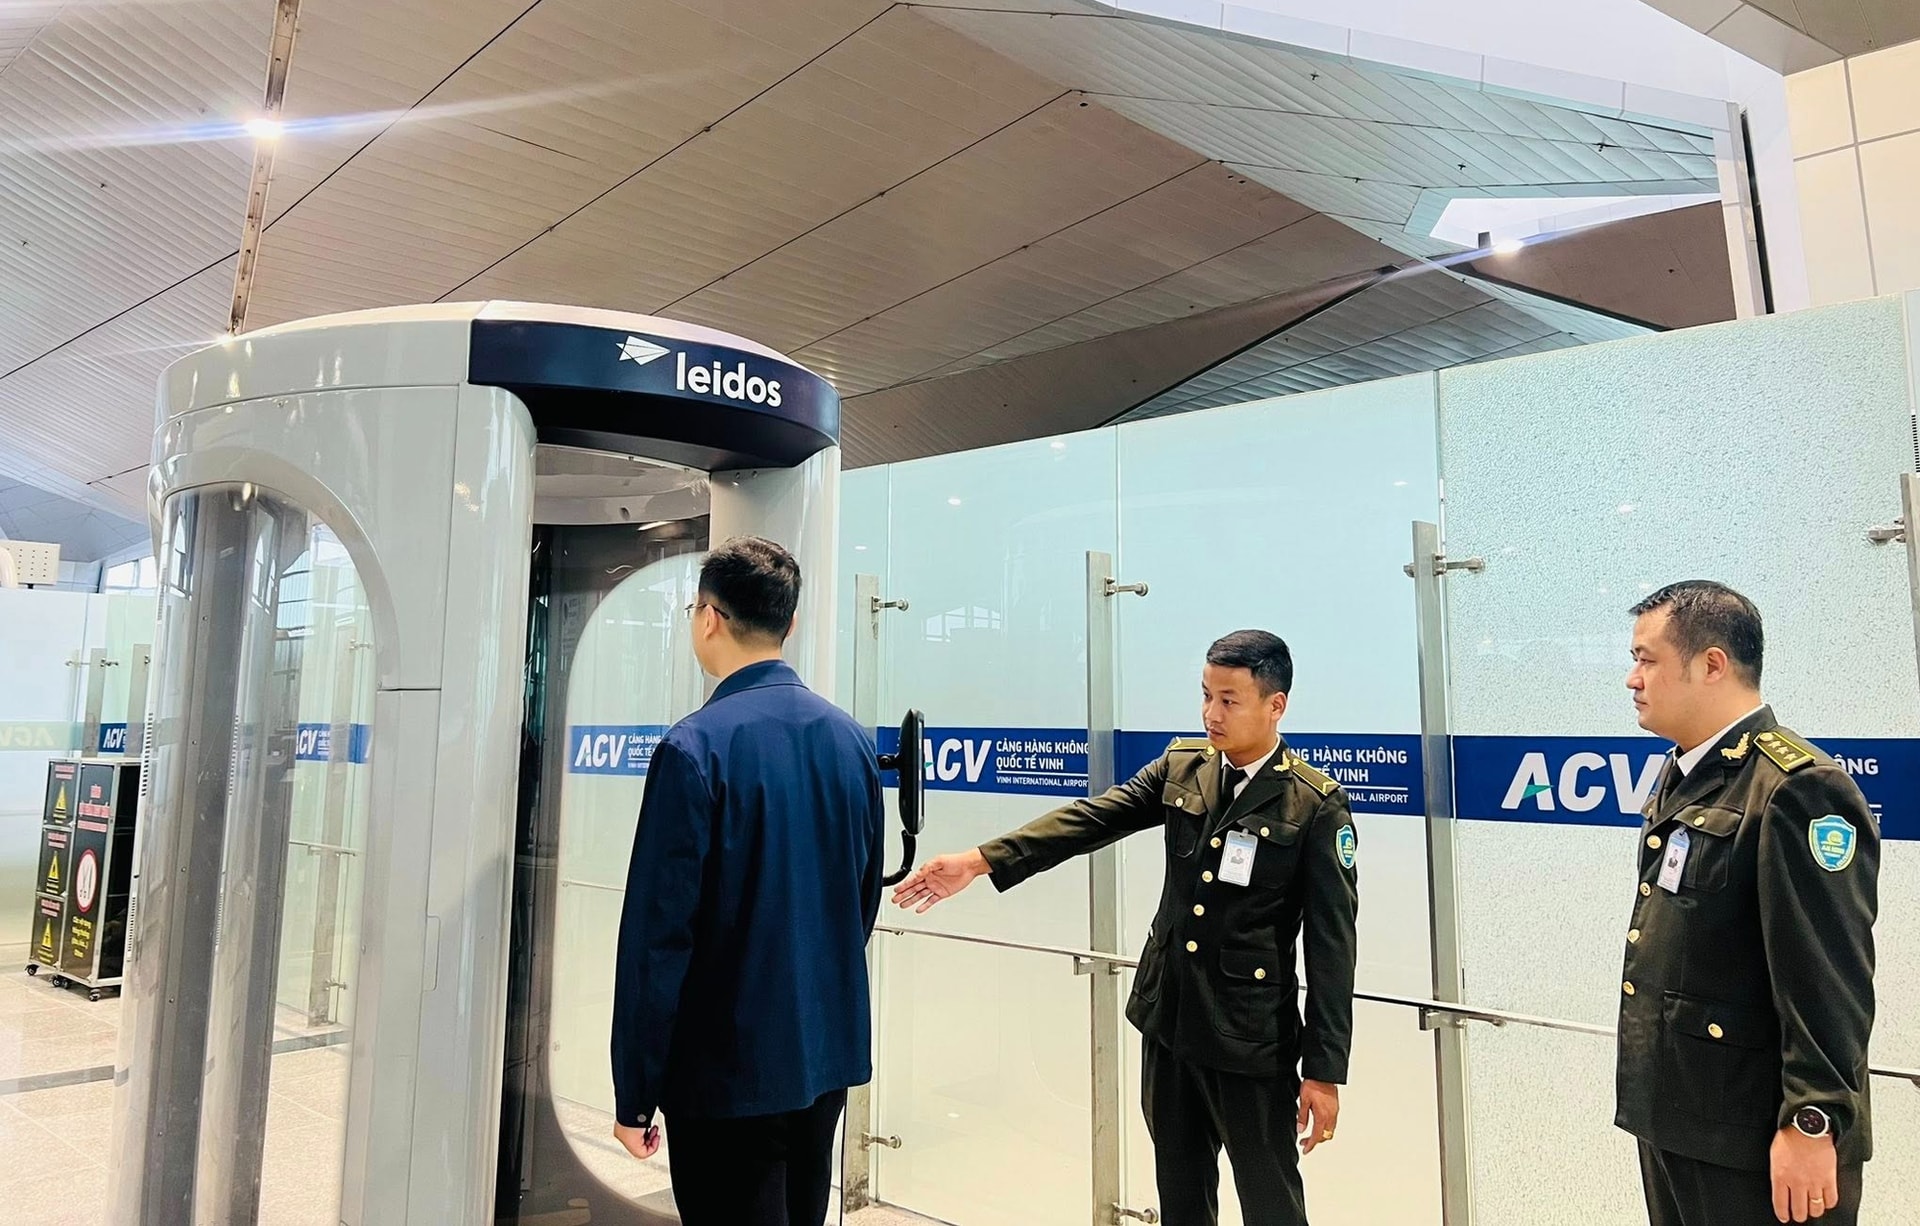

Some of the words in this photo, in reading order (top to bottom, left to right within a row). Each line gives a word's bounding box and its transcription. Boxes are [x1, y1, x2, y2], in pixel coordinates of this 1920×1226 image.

[676, 352, 782, 407] leidos
[103, 728, 124, 748] ACV
[296, 729, 317, 755] CV
[996, 738, 1022, 753] CẢNG
[1024, 738, 1052, 753] HÀNG
[575, 734, 627, 768] ACV
[1290, 748, 1309, 761] NG
[1313, 745, 1352, 763] HÀNG
[1356, 747, 1408, 764] KHÔNG
[996, 753, 1022, 771] QUỐC
[1024, 753, 1038, 769] TẾ
[1039, 758, 1064, 770] VINH
[996, 775, 1012, 784] VINH
[1012, 776, 1062, 787] INTERNATIONAL
[1063, 778, 1088, 788] AIRPOR
[1334, 768, 1369, 782] VINH
[1501, 752, 1667, 814] ACV
[1369, 793, 1409, 804] AIRPORT
